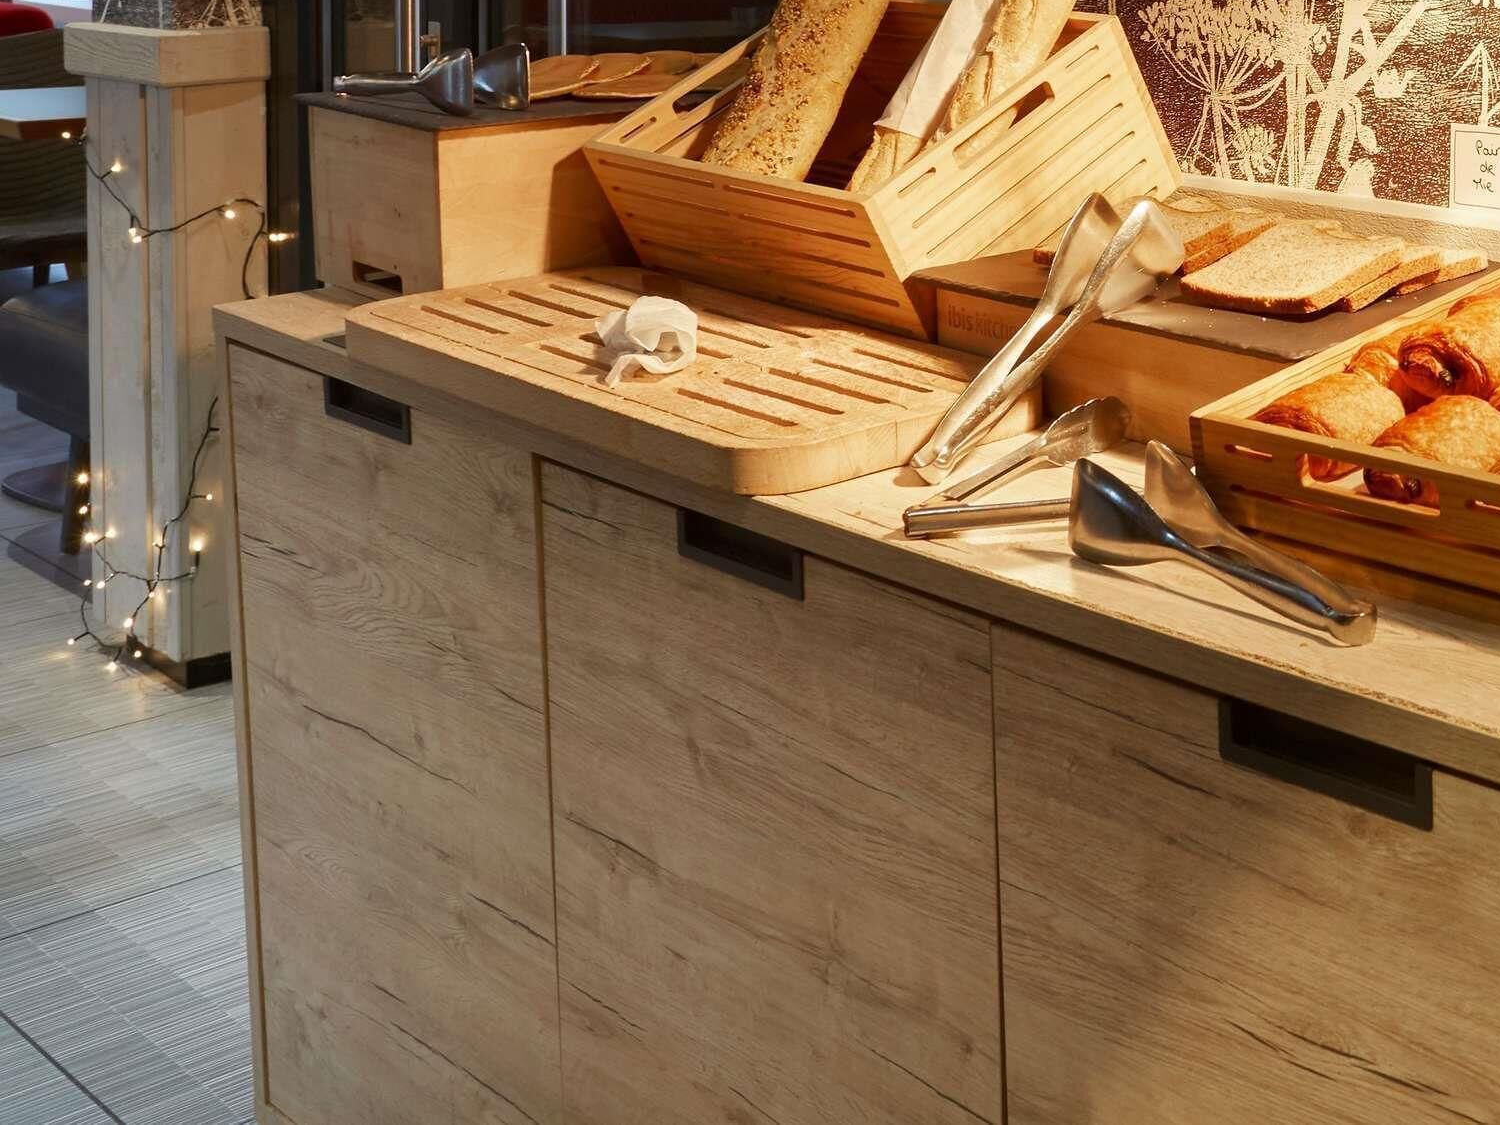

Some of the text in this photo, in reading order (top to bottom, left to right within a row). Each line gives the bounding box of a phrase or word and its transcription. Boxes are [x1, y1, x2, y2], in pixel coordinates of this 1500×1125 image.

[1479, 161, 1496, 176] de
[947, 303, 1017, 341] ibis kitche
